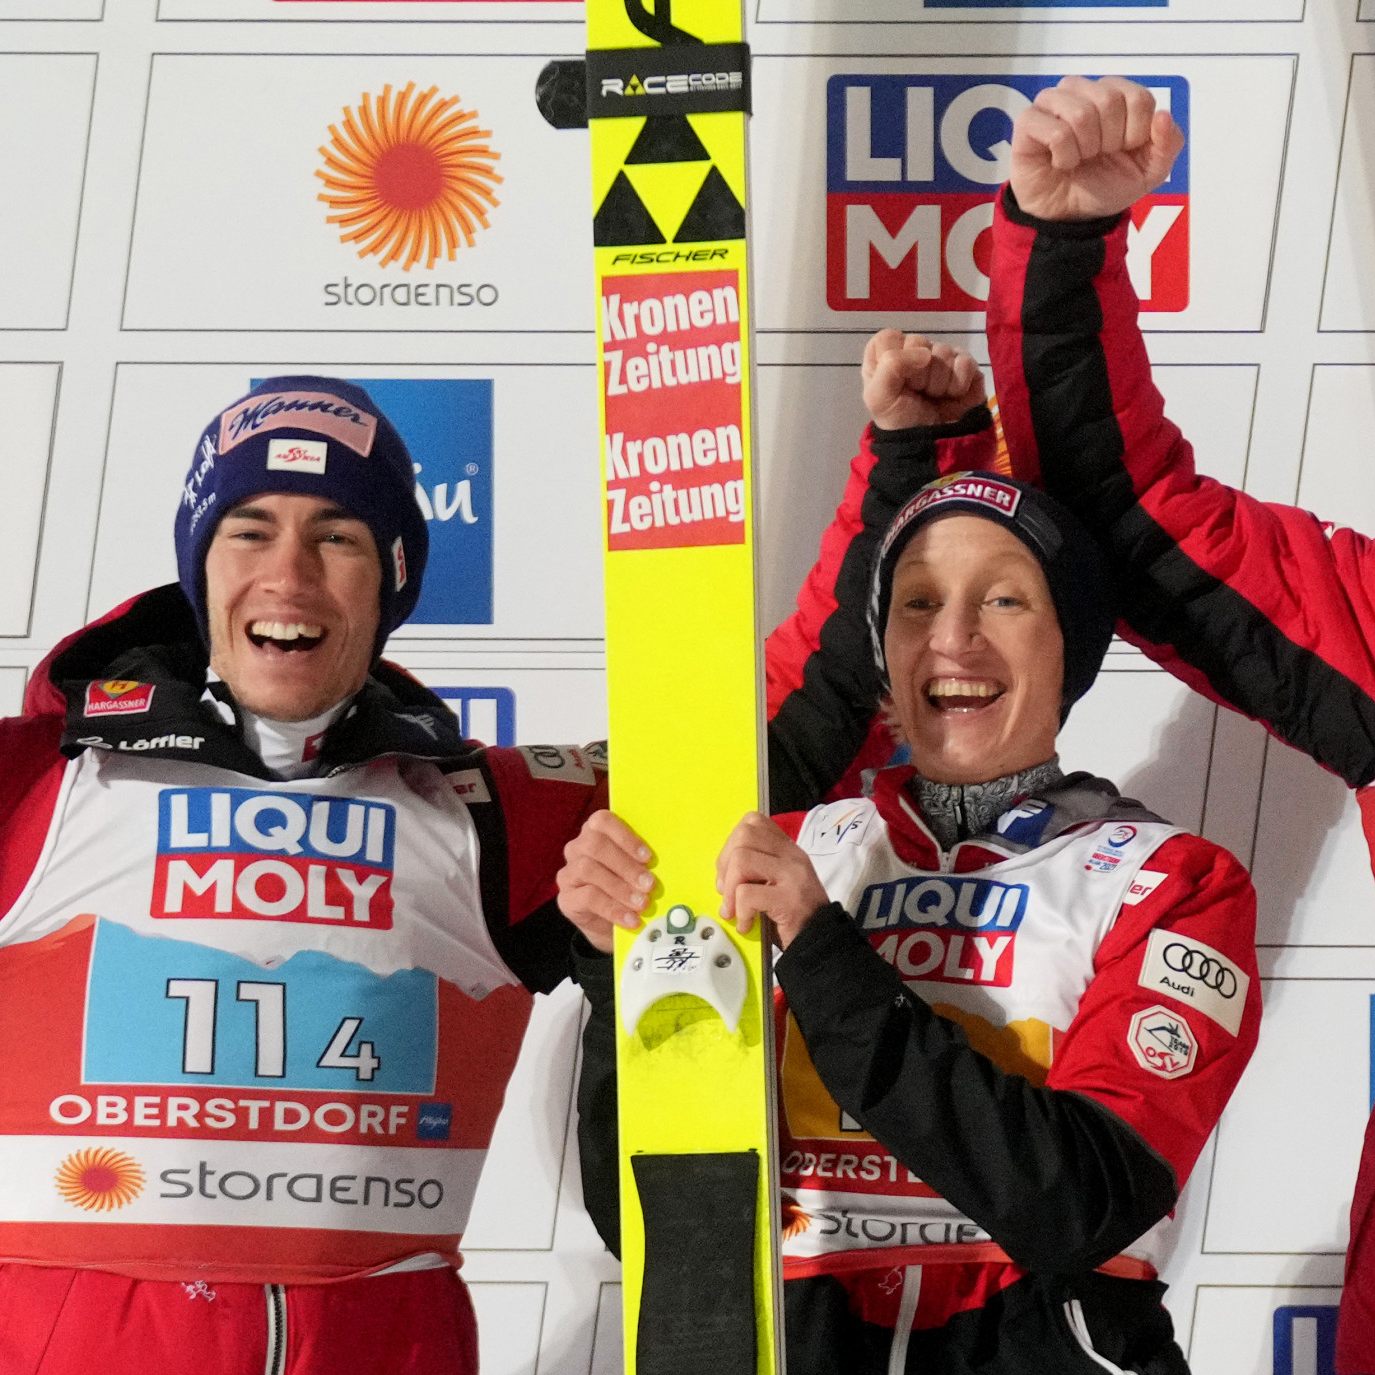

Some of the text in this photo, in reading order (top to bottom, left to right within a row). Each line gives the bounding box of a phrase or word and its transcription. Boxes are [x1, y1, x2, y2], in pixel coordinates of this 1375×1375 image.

[612, 248, 729, 265] FISCHER
[324, 276, 499, 306] storaenso
[602, 285, 739, 343] Kronen
[603, 339, 741, 396] Zeitung
[228, 396, 369, 440] Manner
[605, 425, 742, 482] Kronen
[606, 479, 745, 535] Zeitung
[169, 793, 389, 863] LIQUI
[163, 858, 389, 924] MOLY
[862, 879, 1022, 929] LIQUI
[1159, 976, 1196, 997] Audi
[165, 977, 381, 1081] 11 4
[48, 1093, 410, 1135] OBERSTDORF
[159, 1161, 444, 1209] storaenso
[782, 1150, 924, 1183] OBERST
